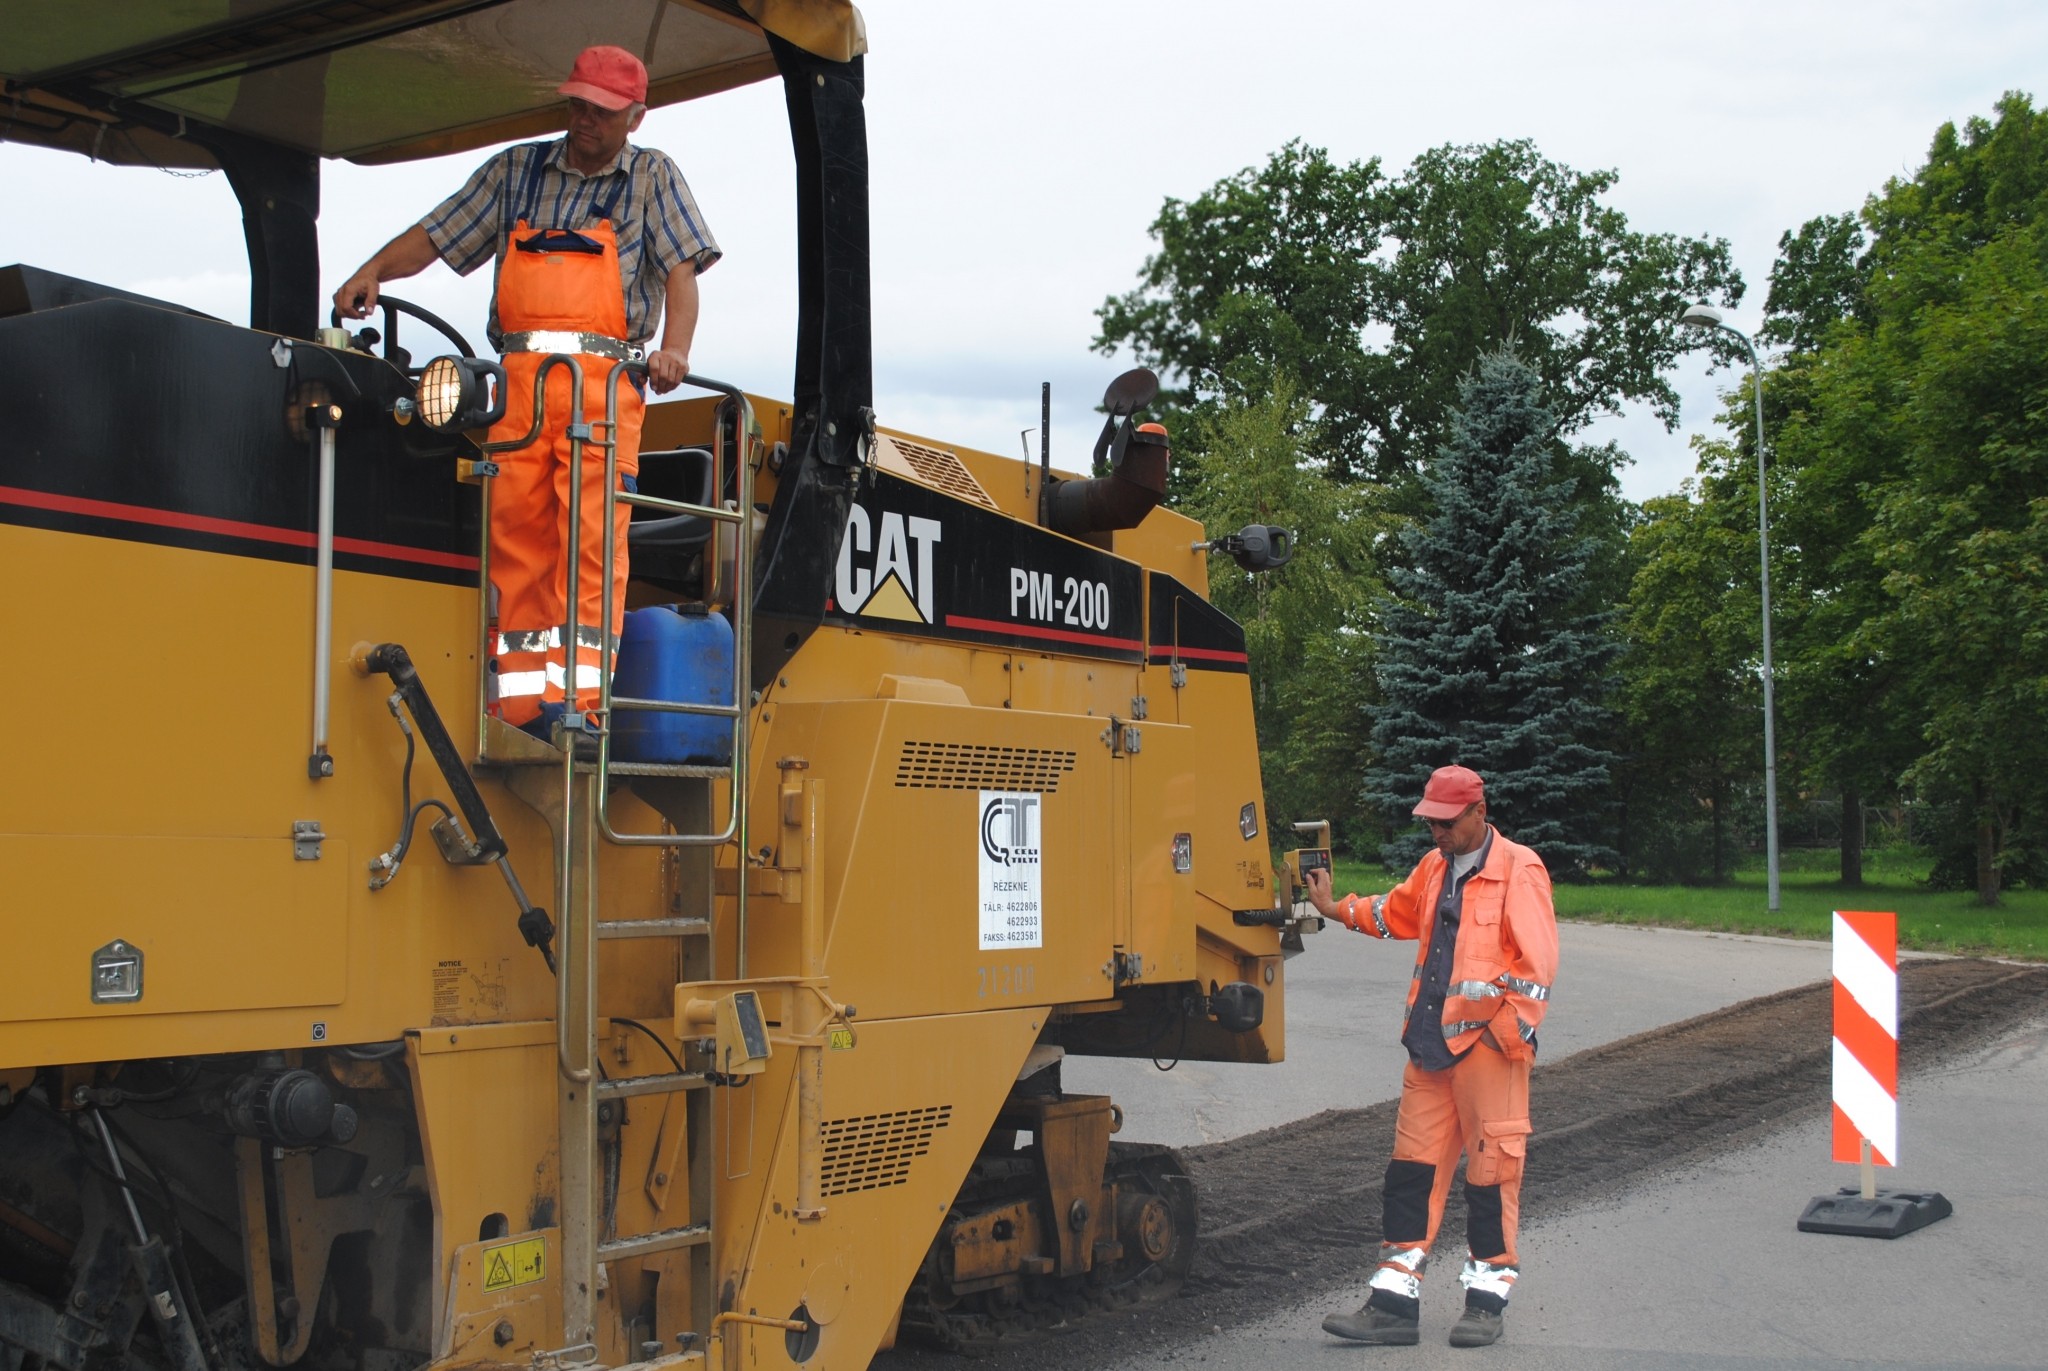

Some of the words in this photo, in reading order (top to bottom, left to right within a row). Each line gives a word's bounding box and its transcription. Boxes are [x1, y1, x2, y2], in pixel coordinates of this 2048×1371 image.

[835, 502, 942, 625] CAT
[1010, 567, 1110, 630] PM-200
[1006, 901, 1038, 912] 4622806
[1006, 916, 1038, 926] 4622933
[983, 933, 1006, 942] FAKSS:
[1006, 931, 1038, 941] 4623581
